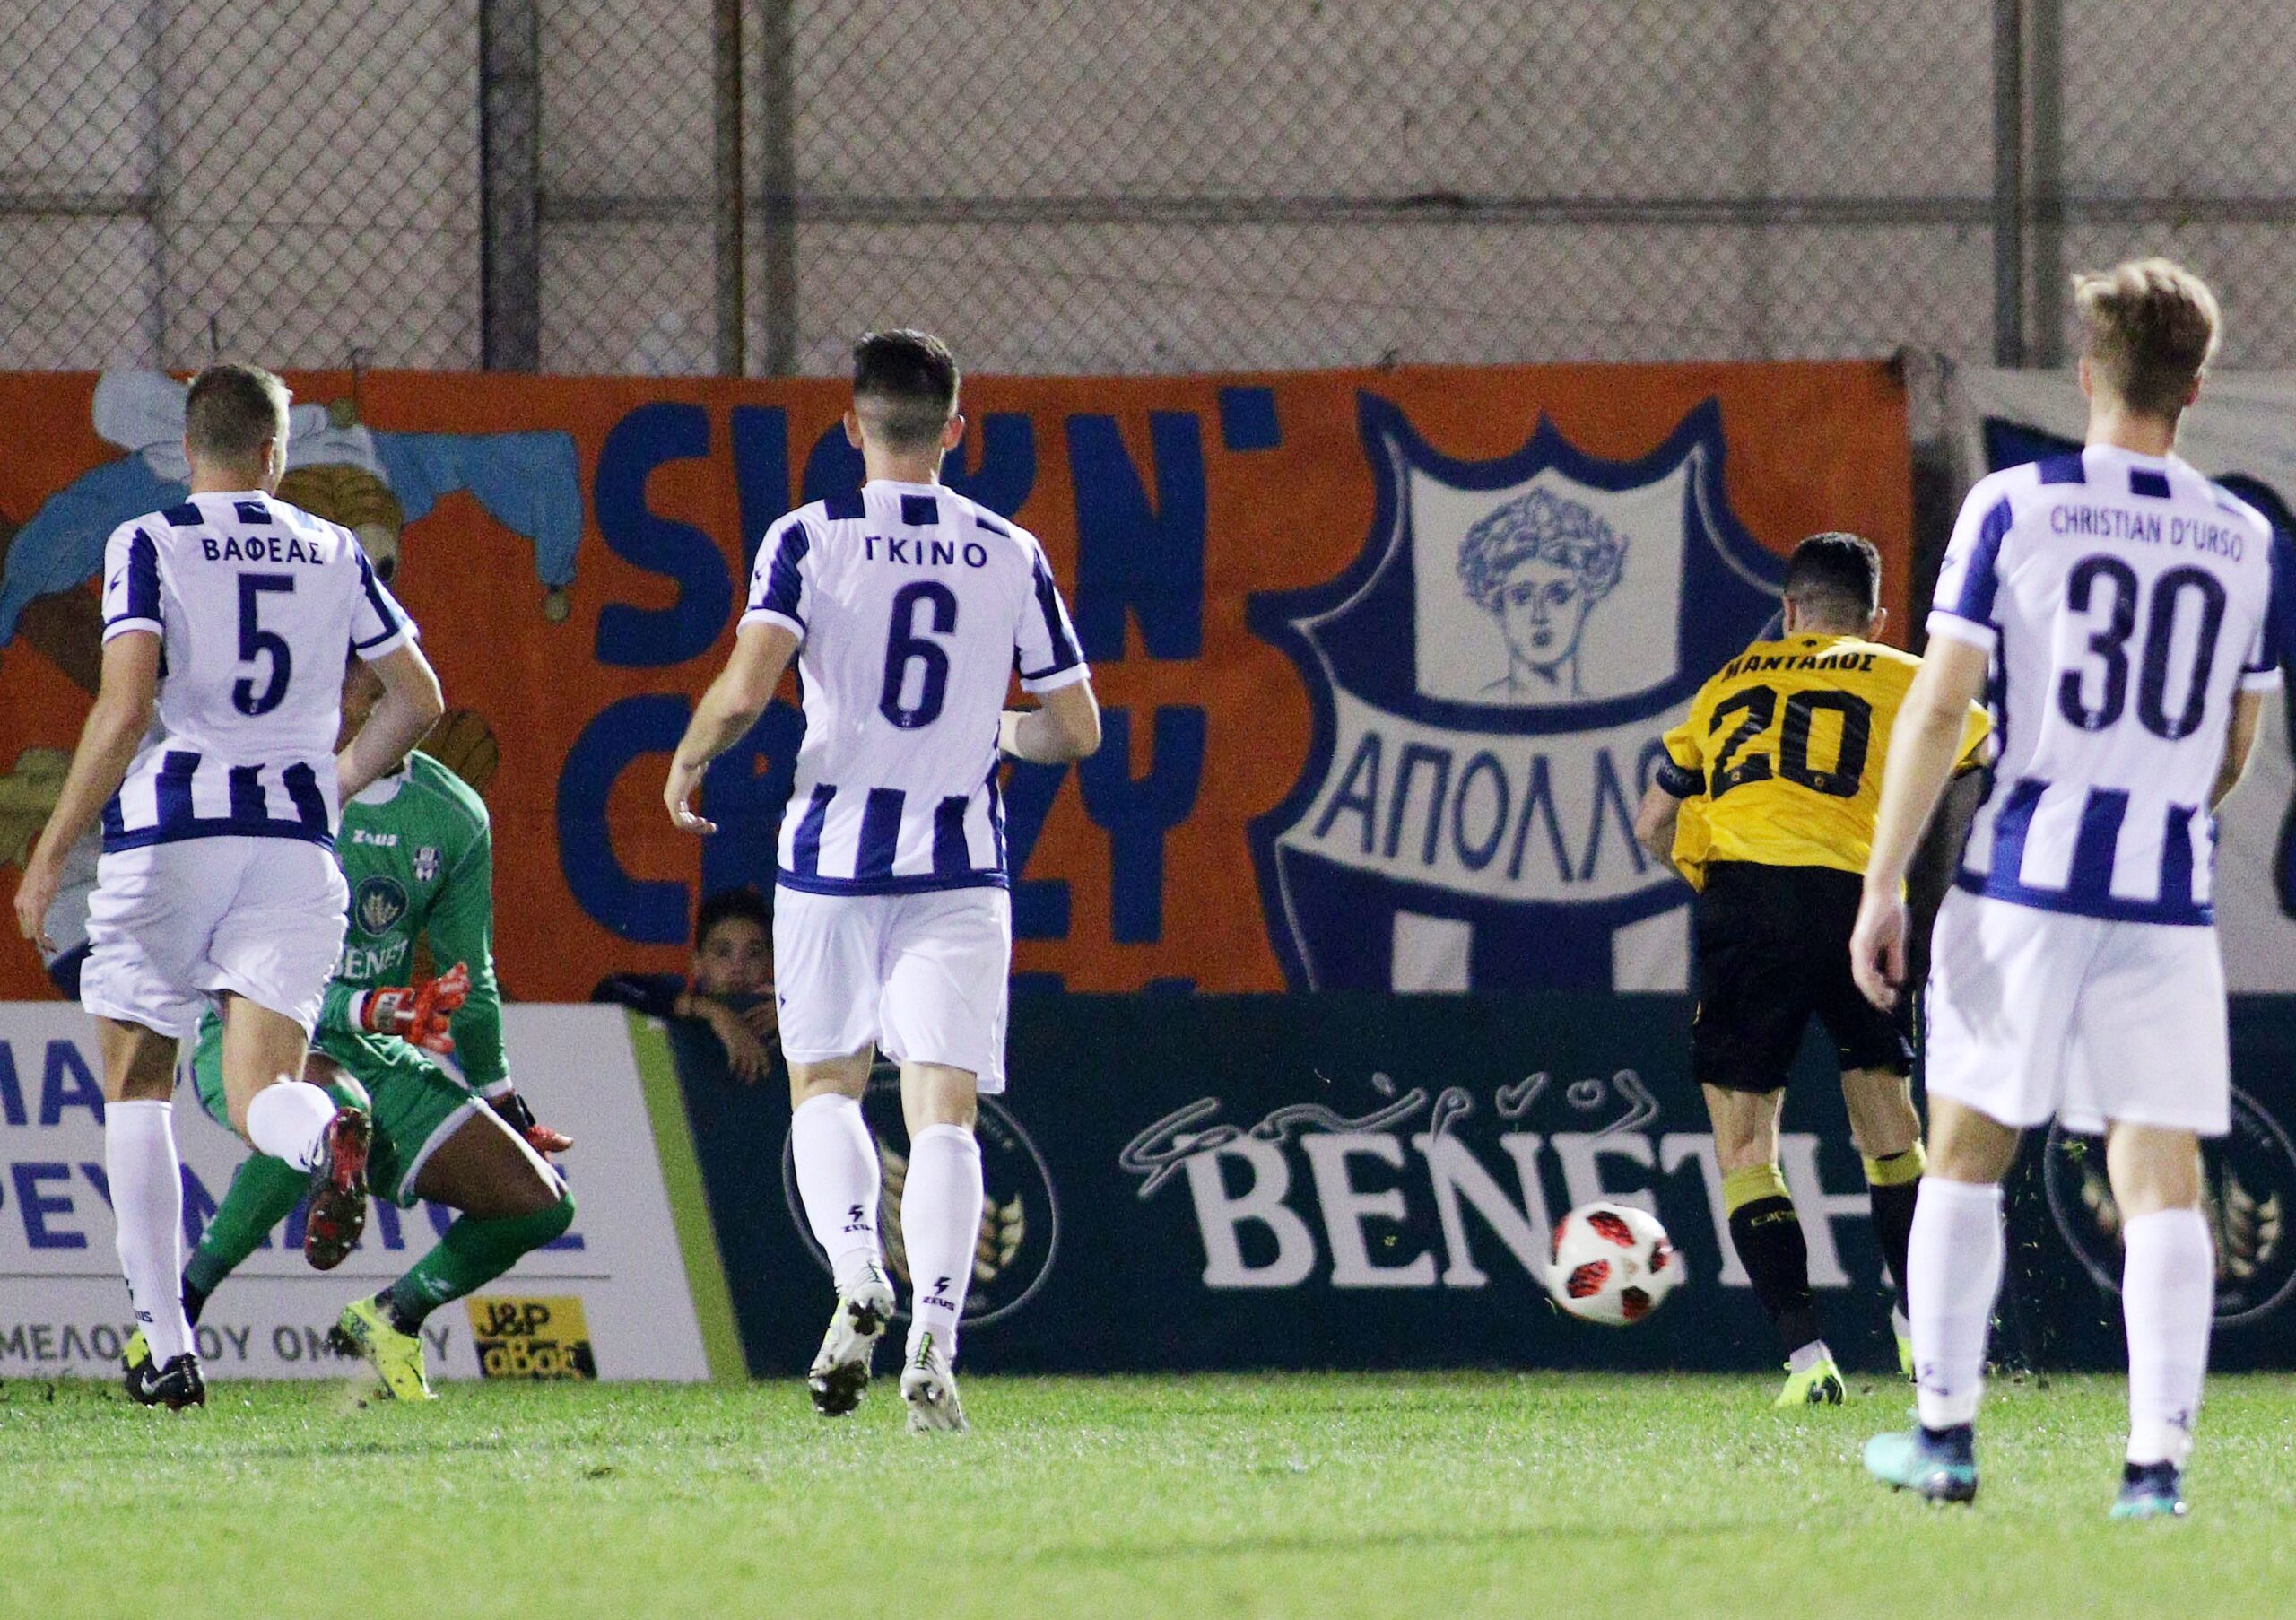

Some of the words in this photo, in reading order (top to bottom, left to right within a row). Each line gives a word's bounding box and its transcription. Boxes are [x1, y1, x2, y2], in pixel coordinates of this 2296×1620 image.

[202, 537, 324, 565] ΒΑΦΕΑΣ
[865, 536, 987, 568] ΓΚΙΝΟ
[2049, 503, 2161, 544] CHRISTIAN
[231, 572, 295, 717] 5
[878, 580, 957, 731] 6
[2057, 552, 2228, 743] 30
[1709, 684, 1873, 801] 20
[195, 1324, 251, 1361] ΟΥ
